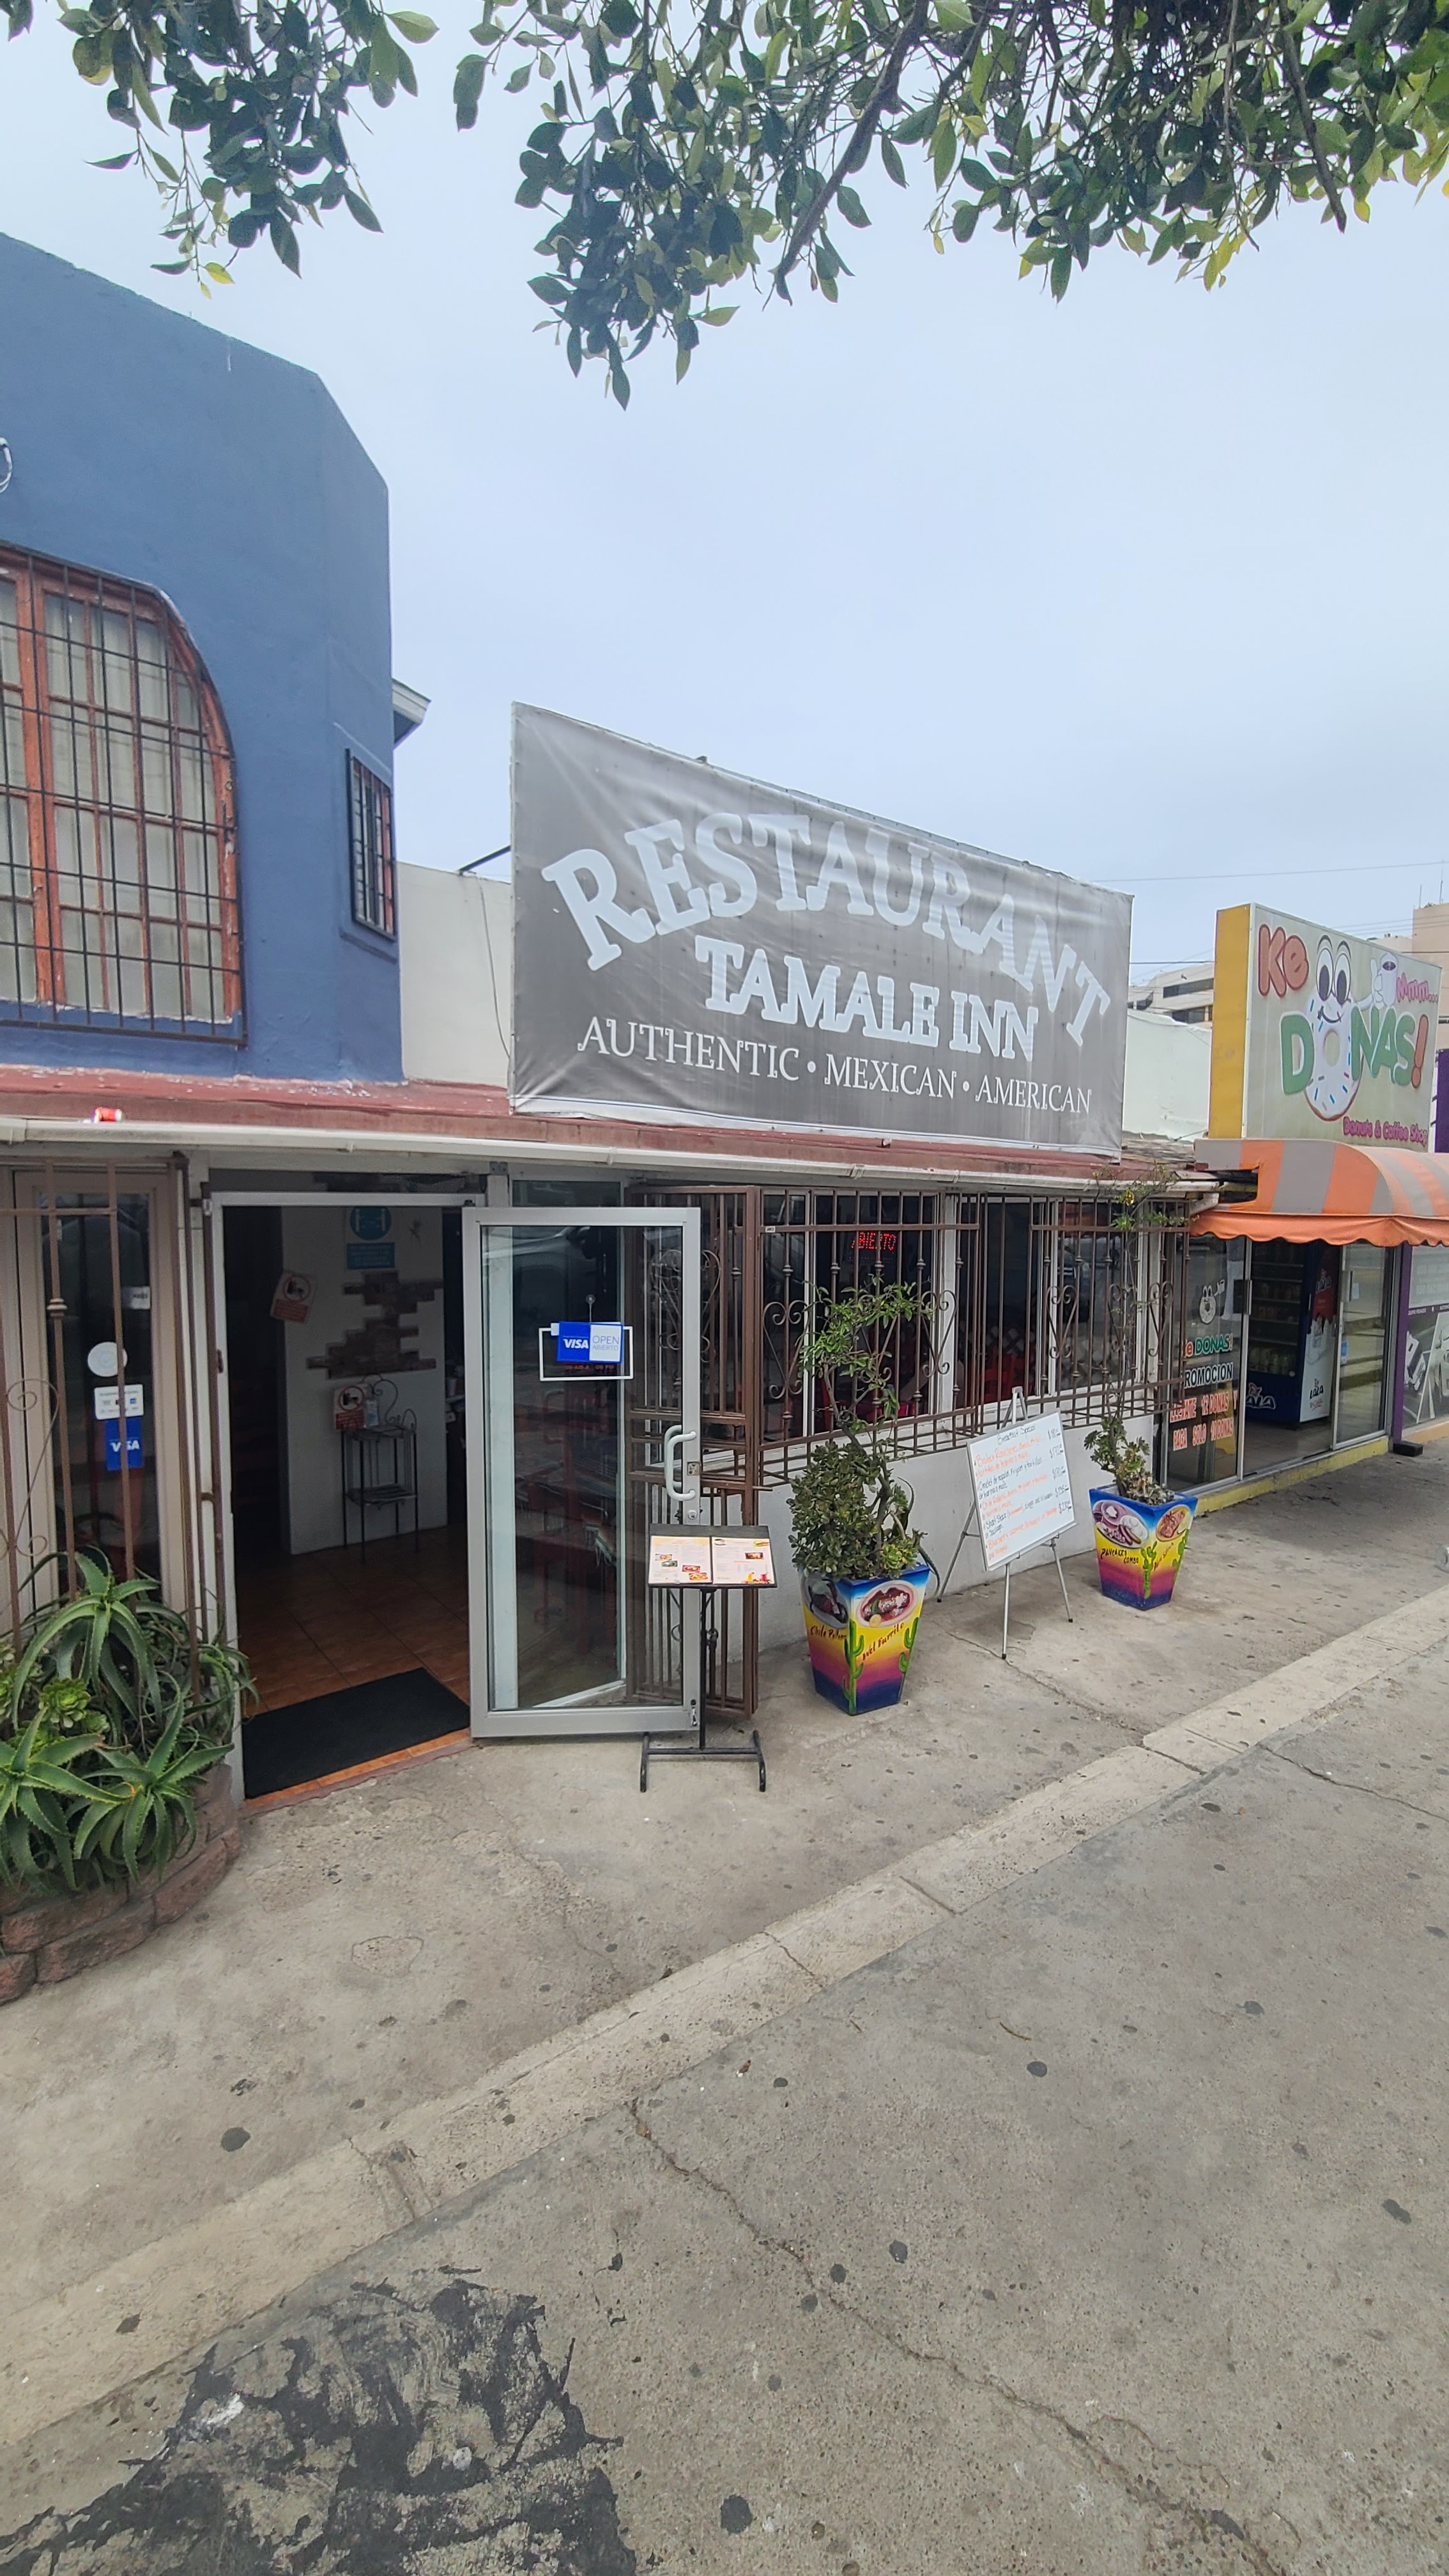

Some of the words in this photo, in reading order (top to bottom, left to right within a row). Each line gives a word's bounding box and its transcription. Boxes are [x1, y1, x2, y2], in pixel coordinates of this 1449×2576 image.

[542, 812, 1110, 1046] RESTAURANT
[695, 935, 940, 1047] TAMALE
[949, 990, 1039, 1062] INN
[578, 1016, 800, 1082] AUTHENTIC
[824, 1054, 957, 1100] MEXICAN
[976, 1074, 1092, 1115] AMERICAN
[1343, 1116, 1373, 1137] Donuts
[1375, 1119, 1382, 1139] &
[1383, 1121, 1409, 1142] Coffee
[1410, 1123, 1428, 1147] Shop
[563, 1338, 589, 1349] VISA
[592, 1335, 619, 1345] OPEN
[1195, 1333, 1234, 1356] DONAS!
[1181, 1362, 1234, 1390] ROMOCION
[1209, 1391, 1229, 1414] DONAS
[1233, 1390, 1238, 1410] Y
[109, 1439, 141, 1452] VSA
[1173, 1427, 1188, 1452] PAGA
